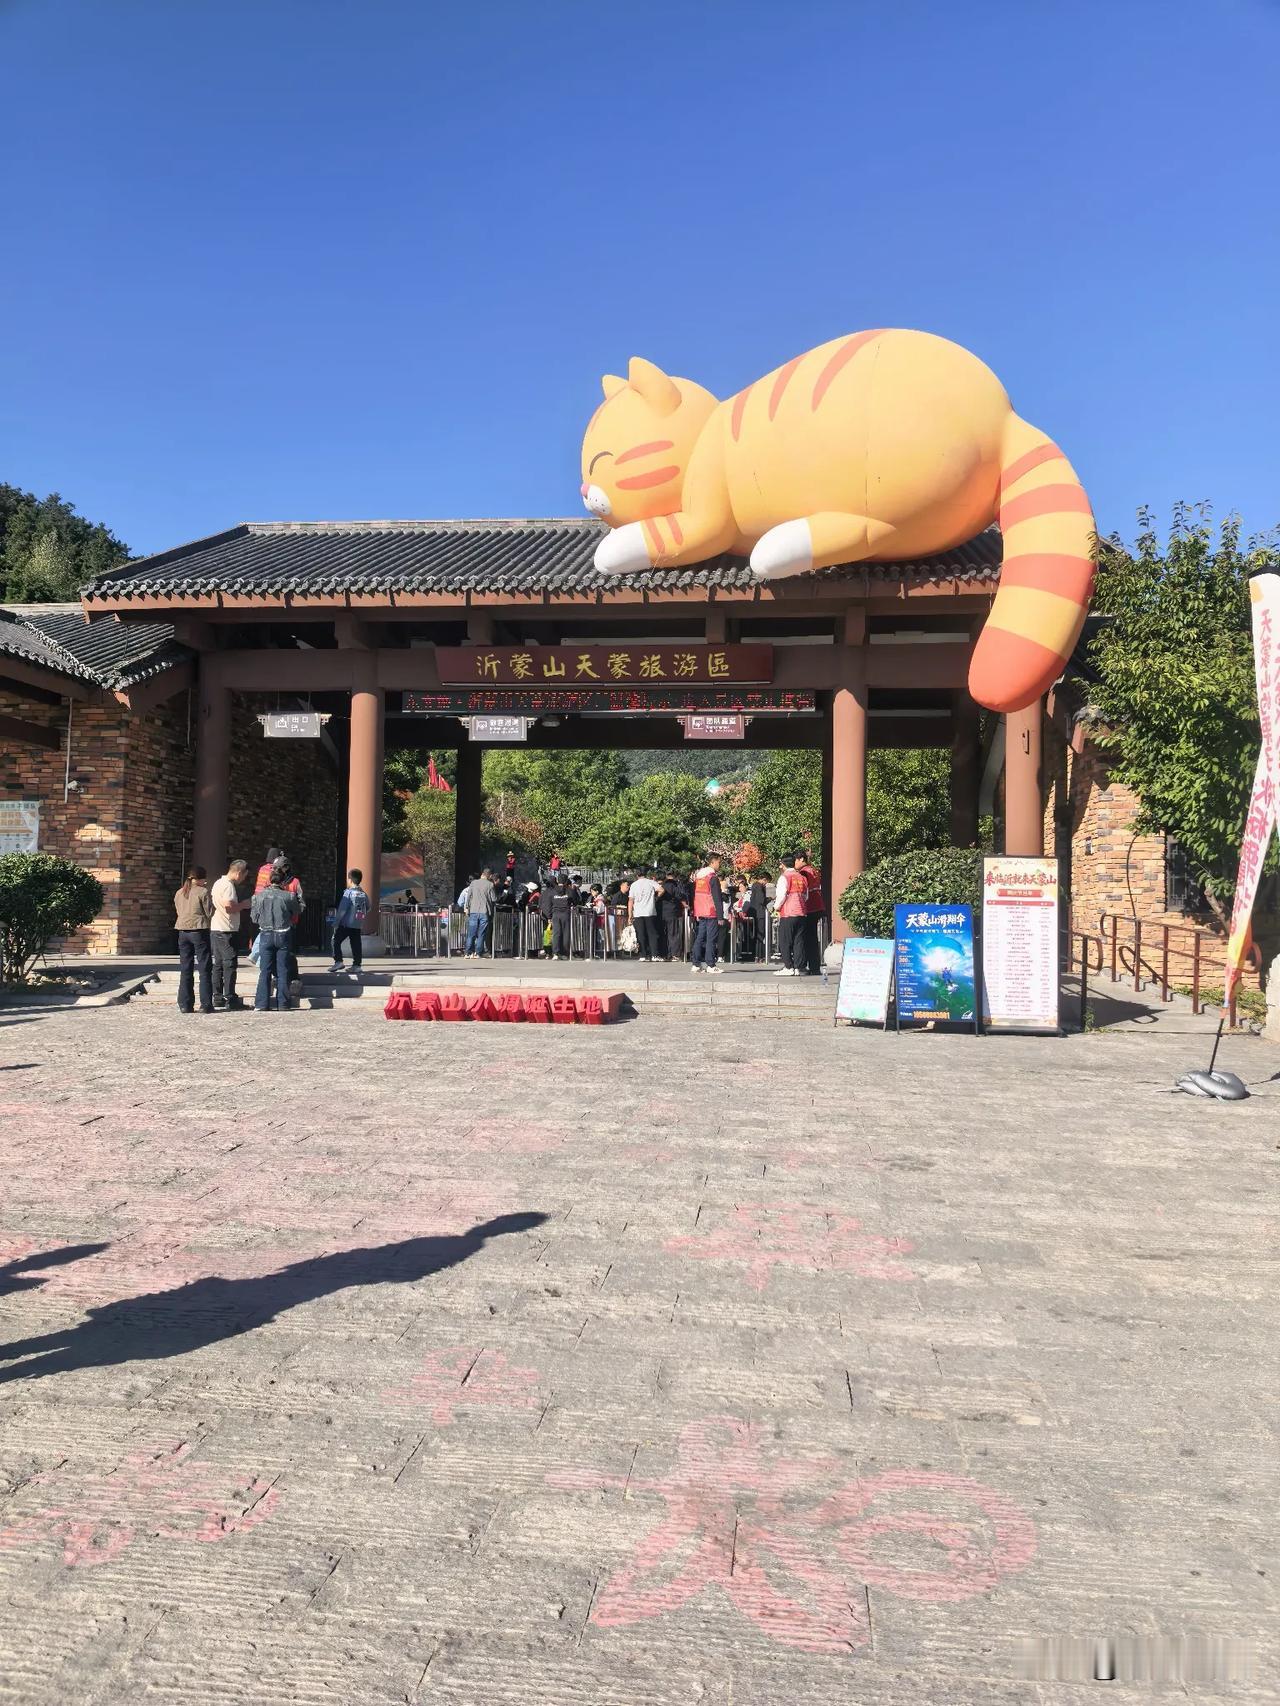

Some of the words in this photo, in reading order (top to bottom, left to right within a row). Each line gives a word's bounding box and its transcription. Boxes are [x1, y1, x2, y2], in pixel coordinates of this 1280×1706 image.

[476, 653, 730, 679] 沂蒙山天蒙旅游區
[984, 871, 1057, 886] 来临沂就来天蒙山
[905, 911, 967, 929] 天蒙山滑翔伞
[385, 991, 604, 1019] 沂蒙山小调诞生地
